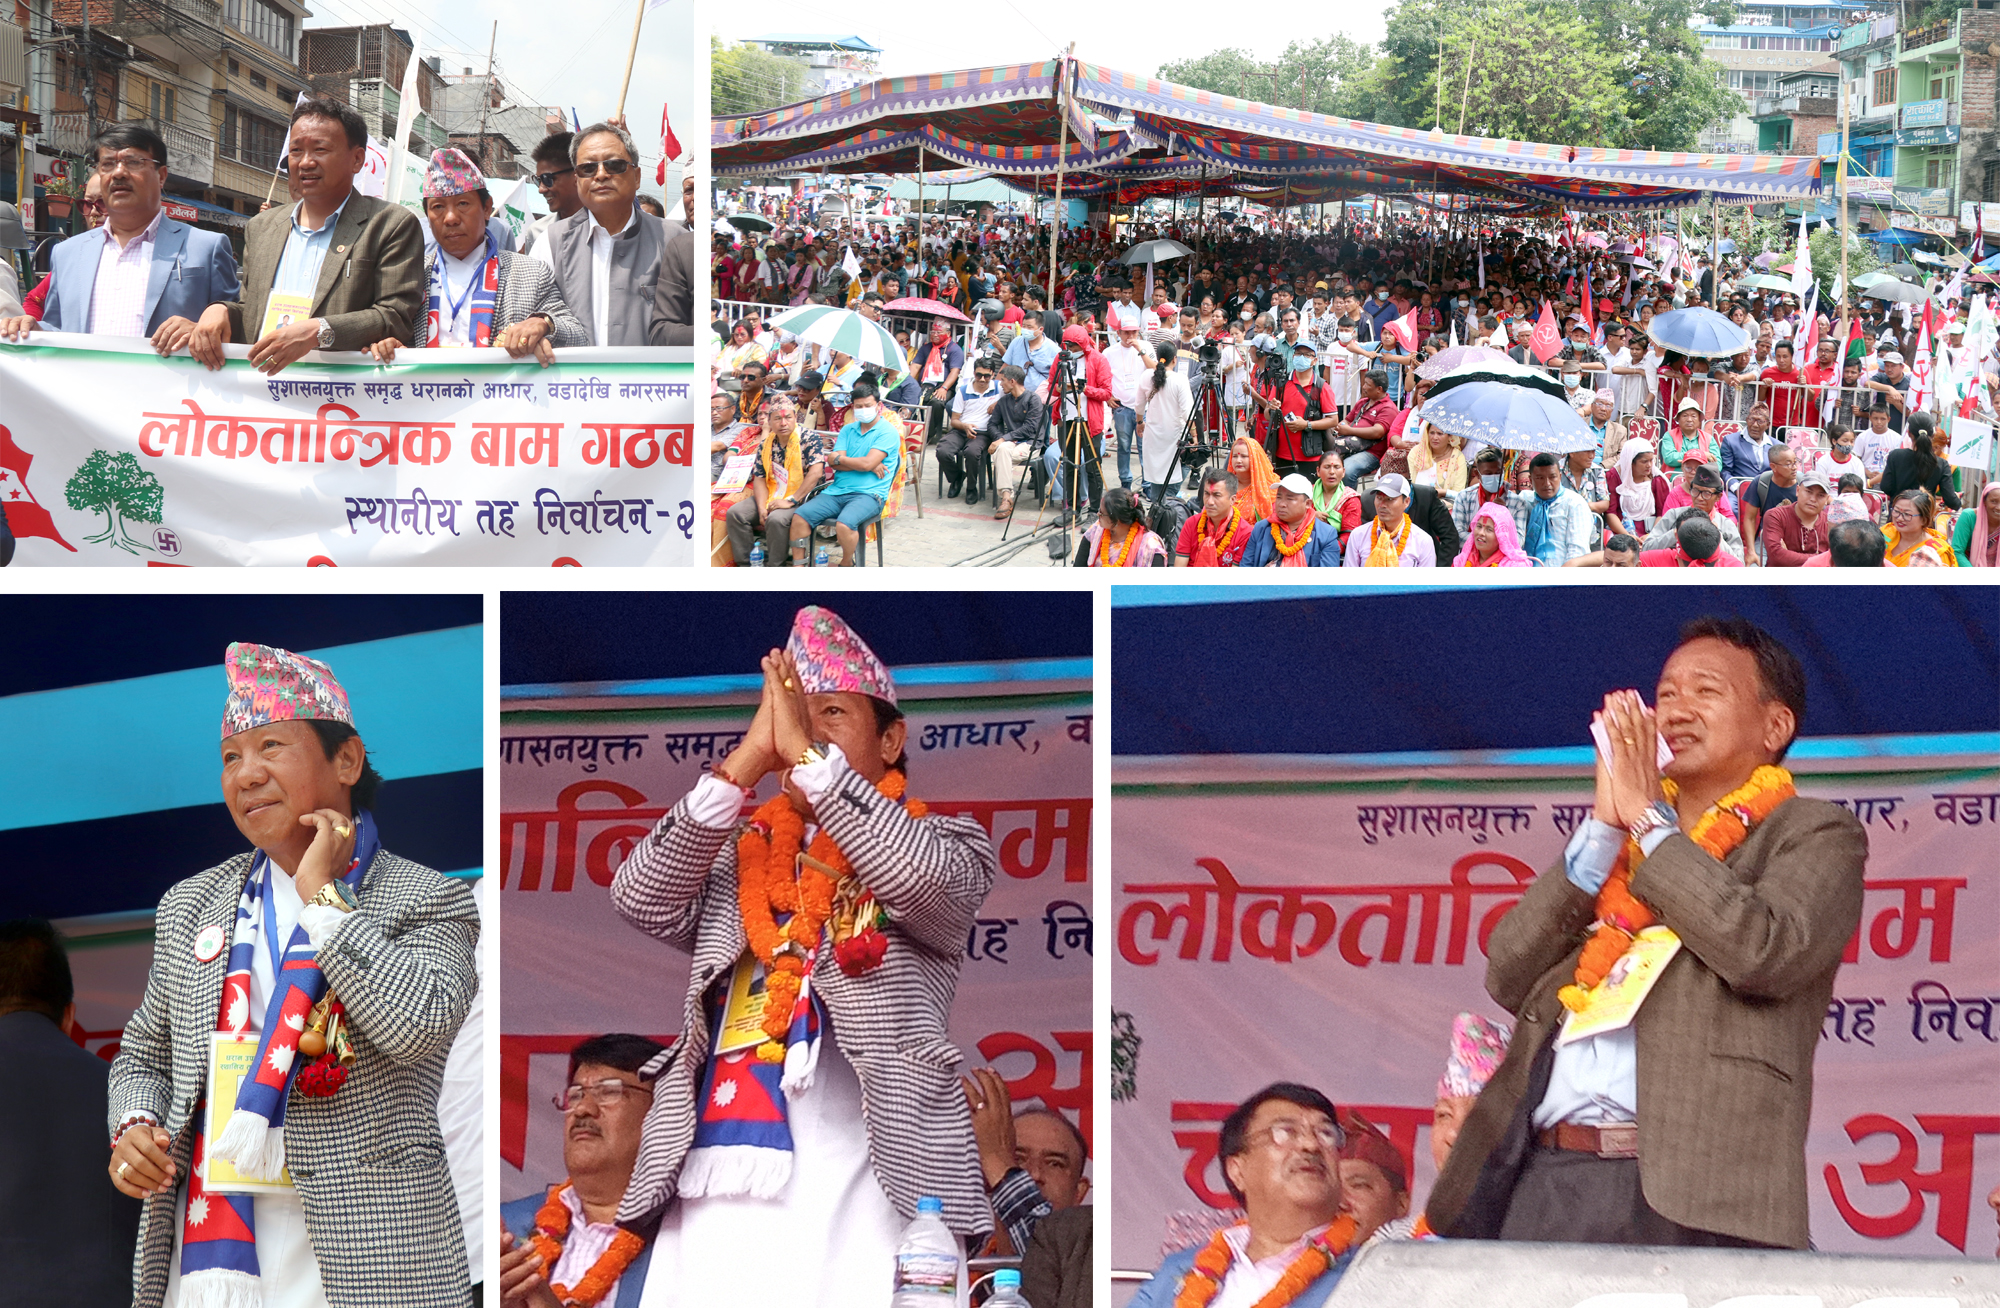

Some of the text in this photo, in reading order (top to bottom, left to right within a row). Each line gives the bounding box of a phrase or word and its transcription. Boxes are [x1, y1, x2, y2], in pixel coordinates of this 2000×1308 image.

[1746, 56, 1813, 67] COMPLEX
[169, 205, 198, 219] ज्वेलर्स
[267, 376, 690, 404] सुशासनयुक्त समृद्ध धरानको आधार, वडादेखि नगरसम्म
[138, 398, 456, 468] लोकतान्त्रिक
[471, 422, 565, 468] बाम
[345, 487, 463, 537] स्थानीय
[475, 499, 520, 539] तह
[919, 719, 1041, 754] आधार,
[1357, 803, 1538, 846] सुशासनयुक्त
